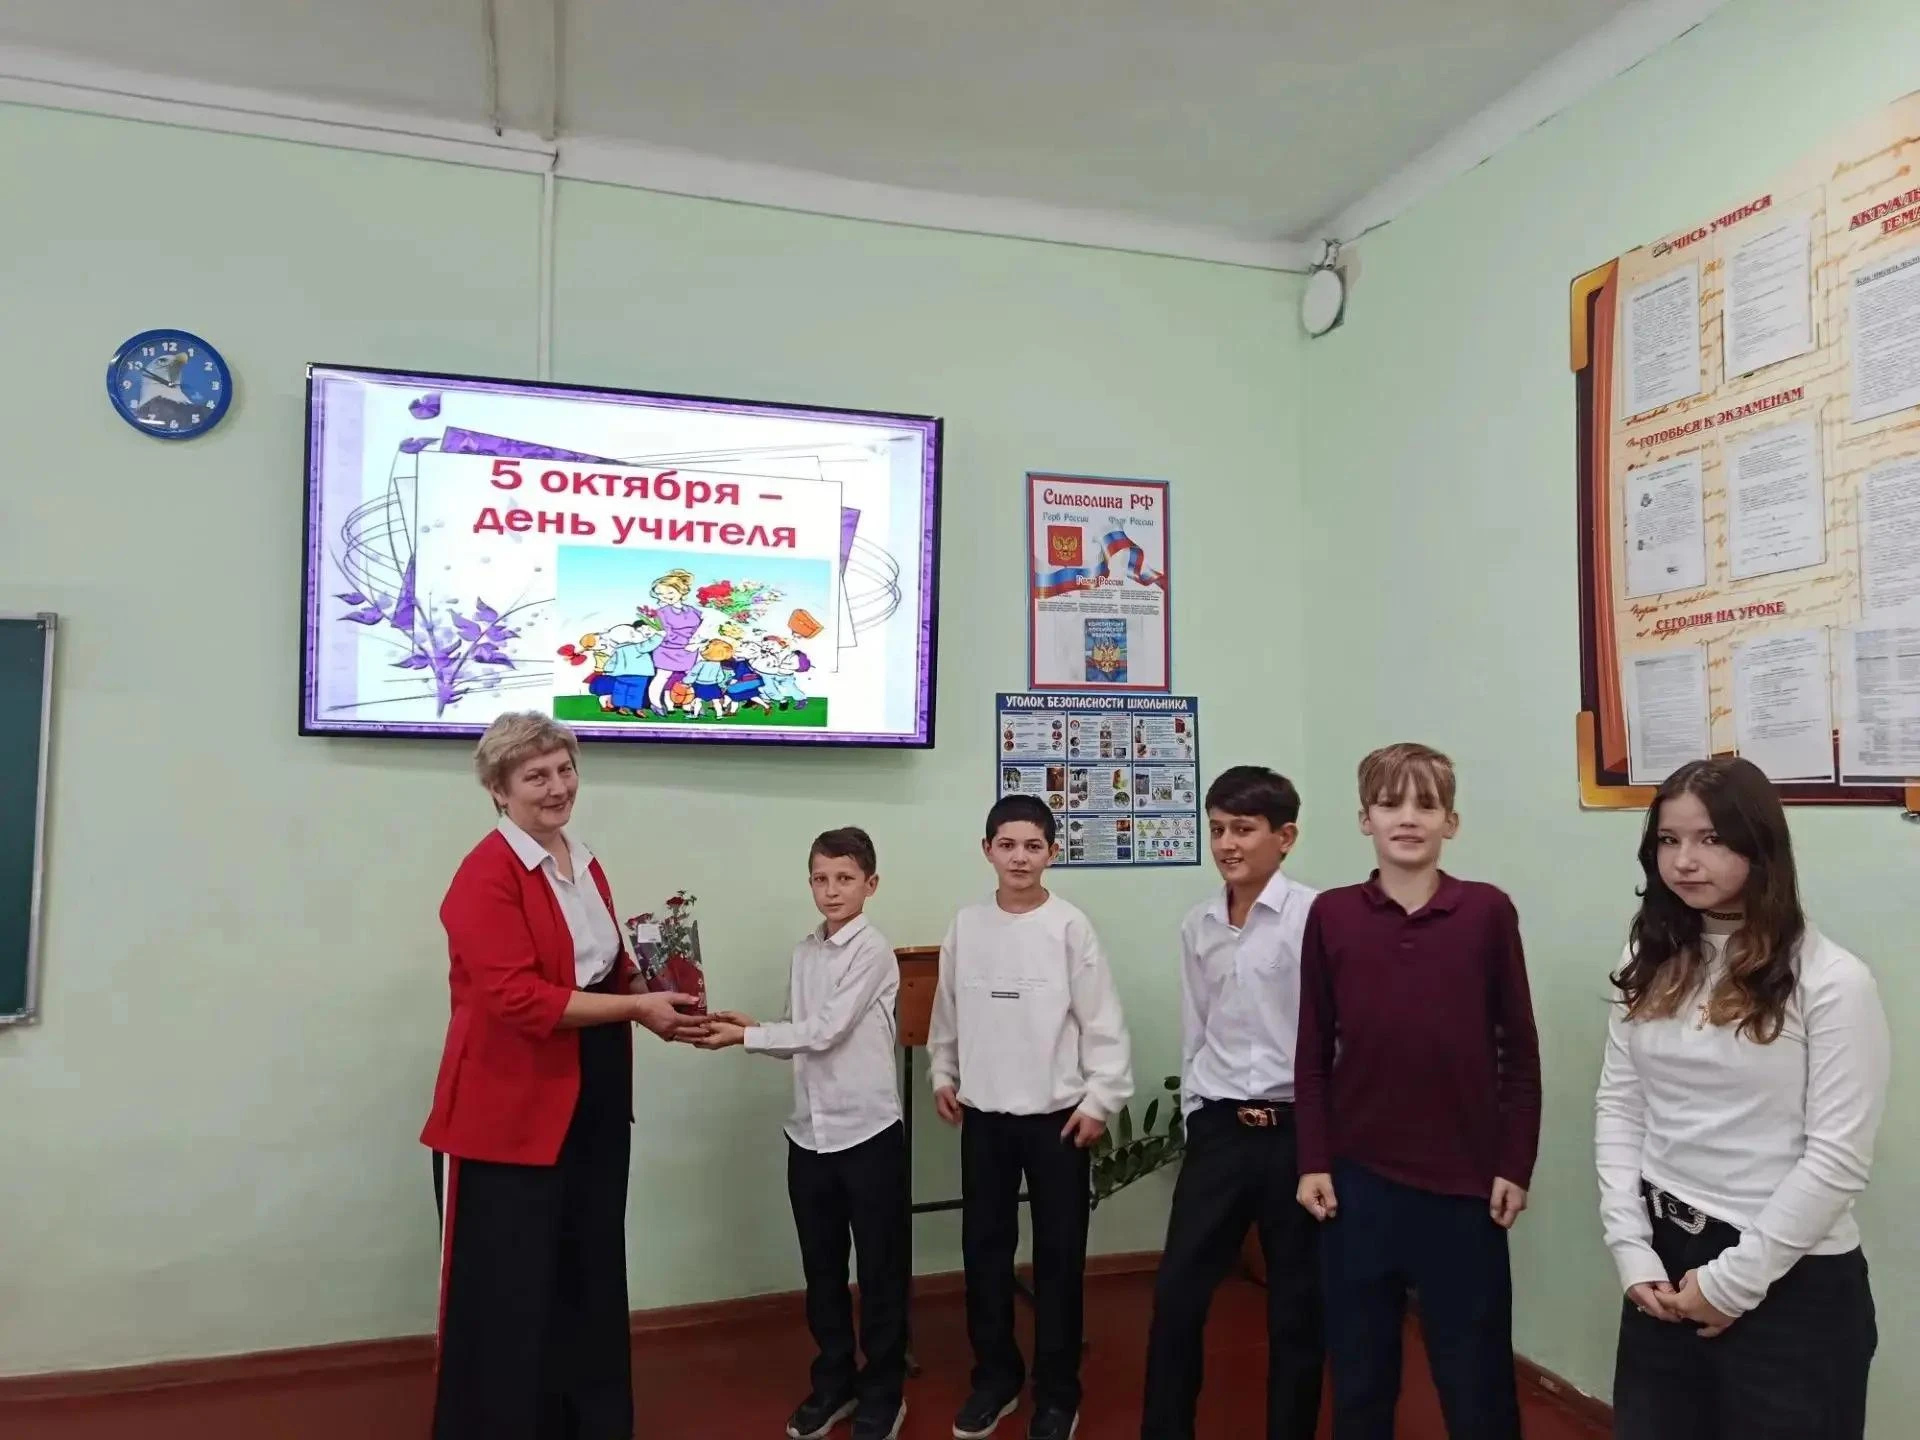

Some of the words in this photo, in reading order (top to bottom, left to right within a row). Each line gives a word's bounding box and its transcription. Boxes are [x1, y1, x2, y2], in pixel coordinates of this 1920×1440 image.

[1710, 194, 1772, 233] УЧИТЬСЯ
[142, 347, 155, 357] 11
[162, 342, 177, 352] 12
[188, 348, 194, 357] 1
[127, 361, 143, 370] 10
[204, 361, 213, 371] 2
[122, 380, 132, 391] 9
[211, 381, 220, 391] 3
[206, 400, 216, 410] 4
[191, 414, 200, 424] 5
[1639, 423, 1701, 449] ГОТОВЬСЯ
[1702, 416, 1713, 429] К
[1716, 384, 1805, 425] ЭКЗАМЕНАМ
[169, 420, 179, 429] 6
[490, 459, 523, 490] 5
[540, 470, 740, 508] октября
[1043, 488, 1123, 509] Символика
[1130, 494, 1154, 510] РФ
[1064, 513, 1089, 523] России
[473, 507, 596, 536] день
[612, 515, 796, 549] учителя
[1655, 614, 1713, 632] СЕГОДНЯ
[1716, 608, 1735, 624] НА
[1739, 601, 1785, 620] УРОКЕ
[1005, 695, 1045, 708] УГОЛОК
[1047, 696, 1124, 709] БЕЗОПАСНОСТИ
[1127, 697, 1188, 710] ШКОЛЬНИКА
